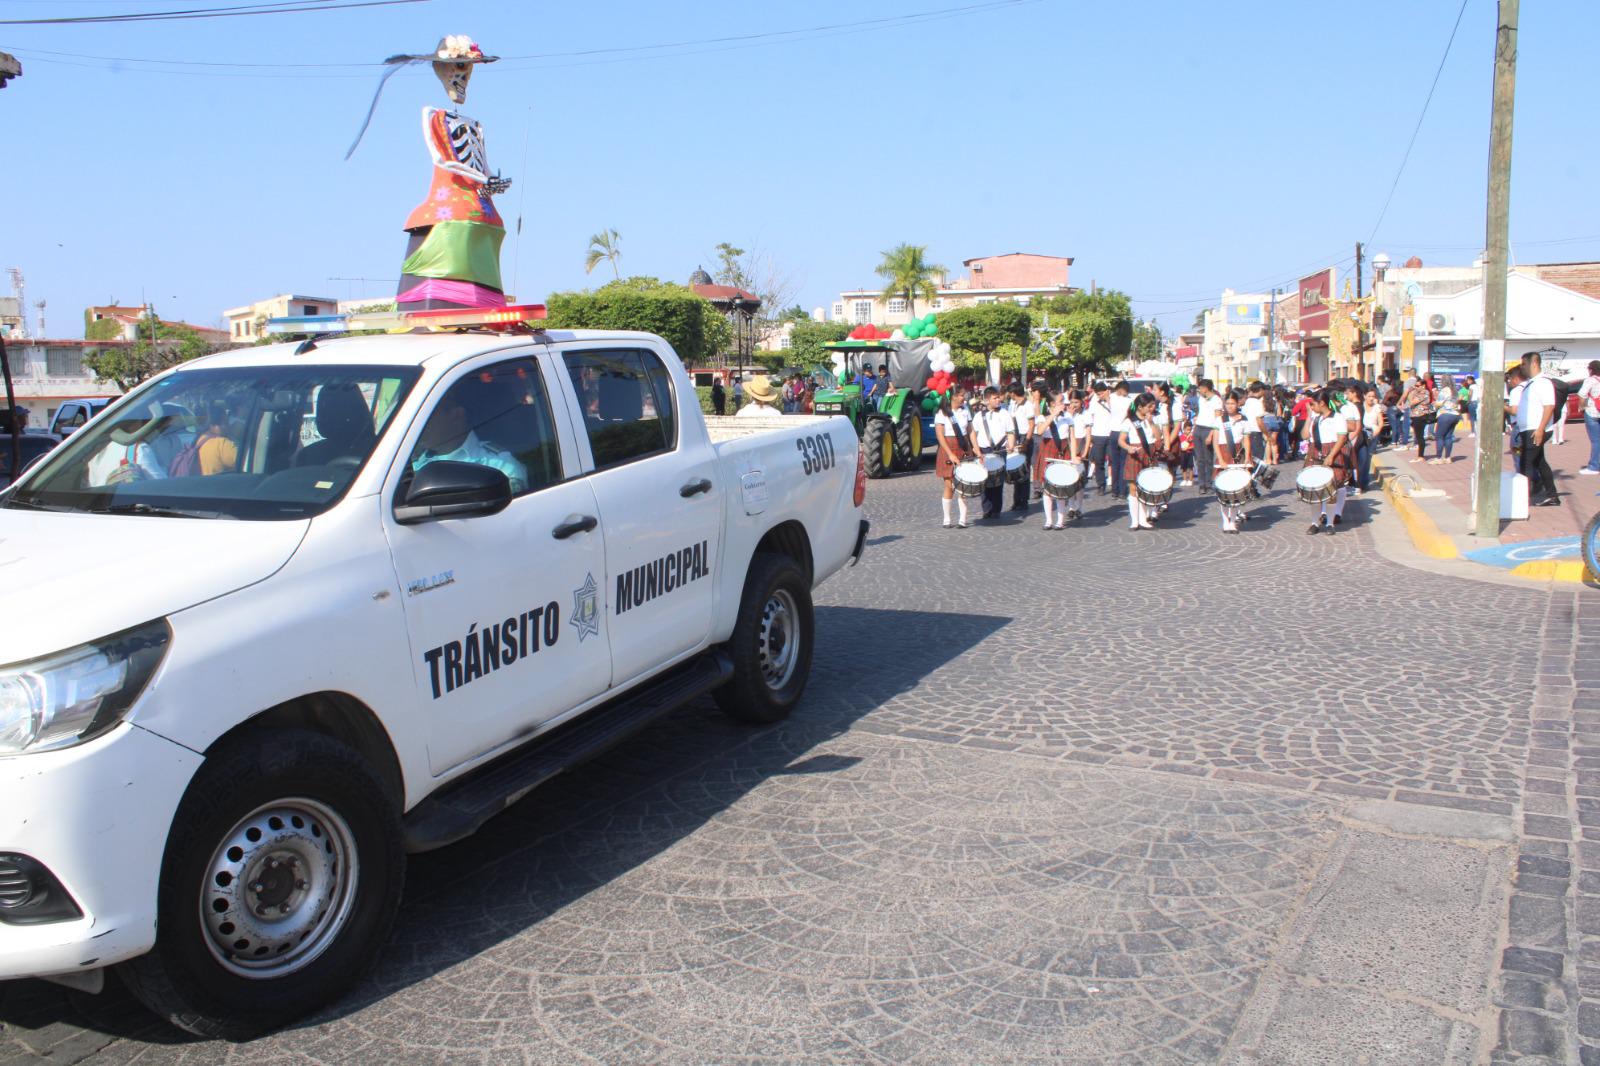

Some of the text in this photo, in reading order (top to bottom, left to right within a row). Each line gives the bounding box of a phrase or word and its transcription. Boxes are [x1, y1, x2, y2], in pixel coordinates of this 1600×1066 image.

[796, 432, 835, 476] 3307
[424, 540, 709, 700] TRÁNSITO MUNICIPAL
